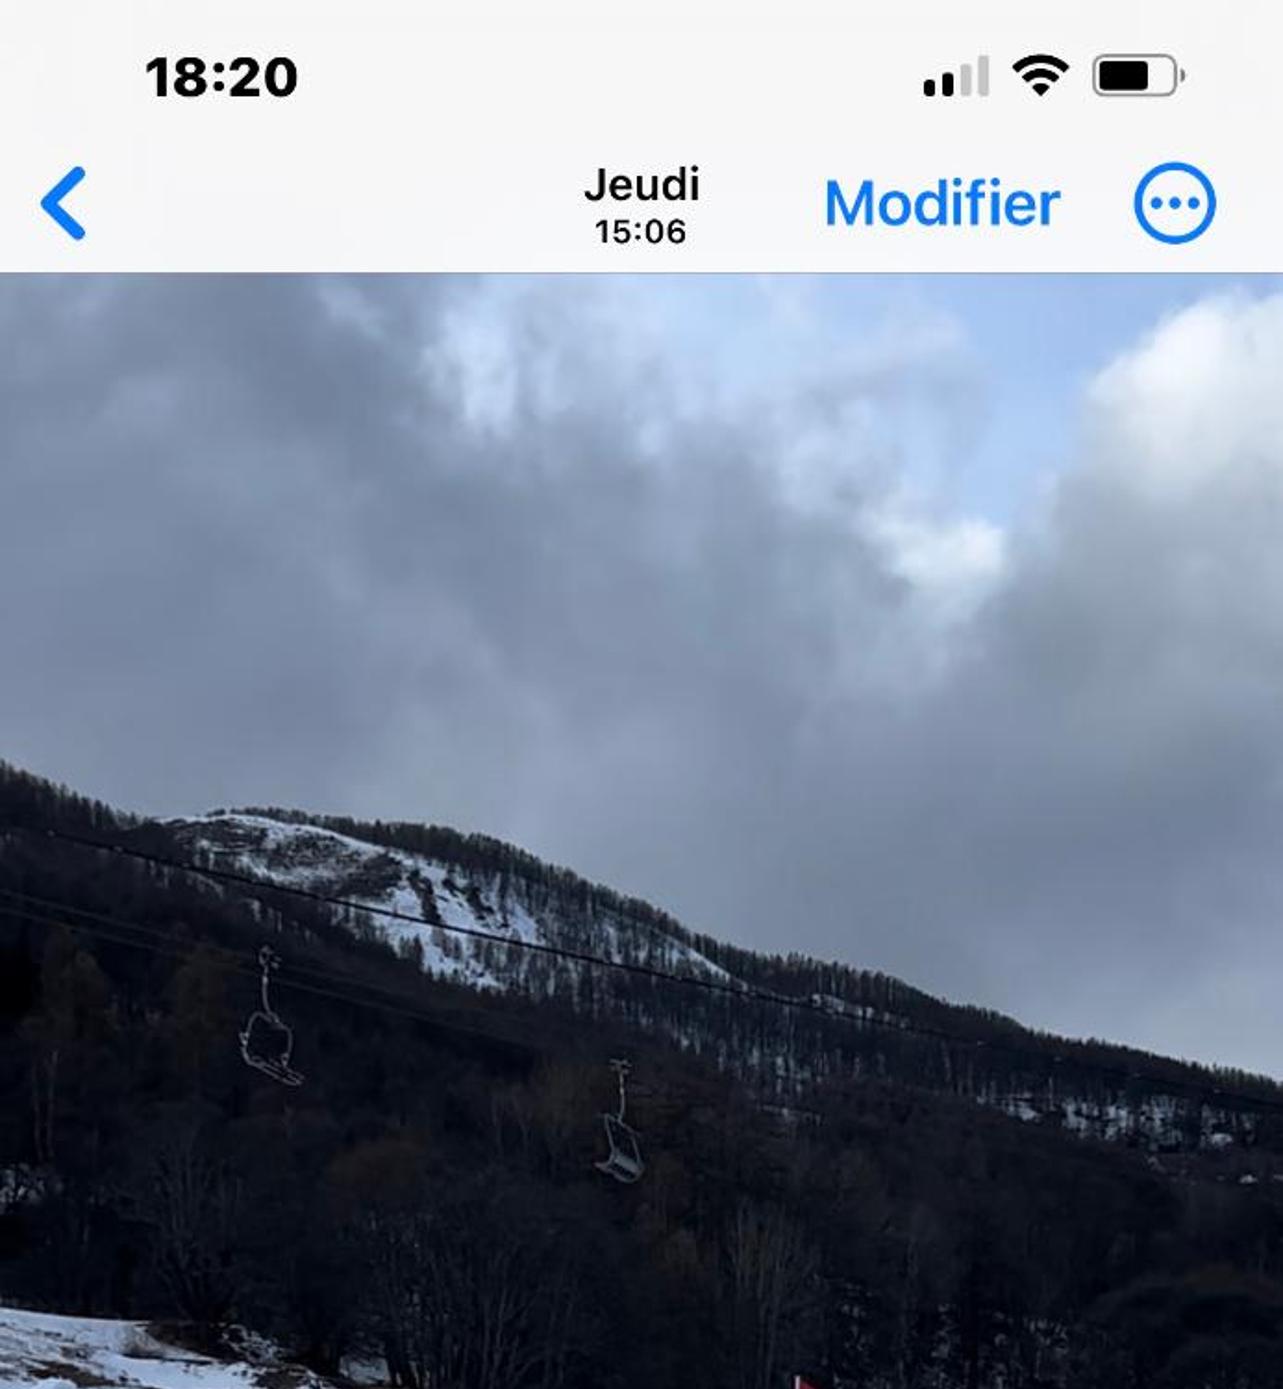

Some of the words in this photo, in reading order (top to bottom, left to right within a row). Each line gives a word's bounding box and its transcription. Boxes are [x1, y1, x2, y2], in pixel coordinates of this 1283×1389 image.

[146, 56, 298, 98] 18:20
[584, 165, 699, 202] Jeudi
[826, 177, 1061, 227] Modifier
[595, 218, 686, 245] 15:06
